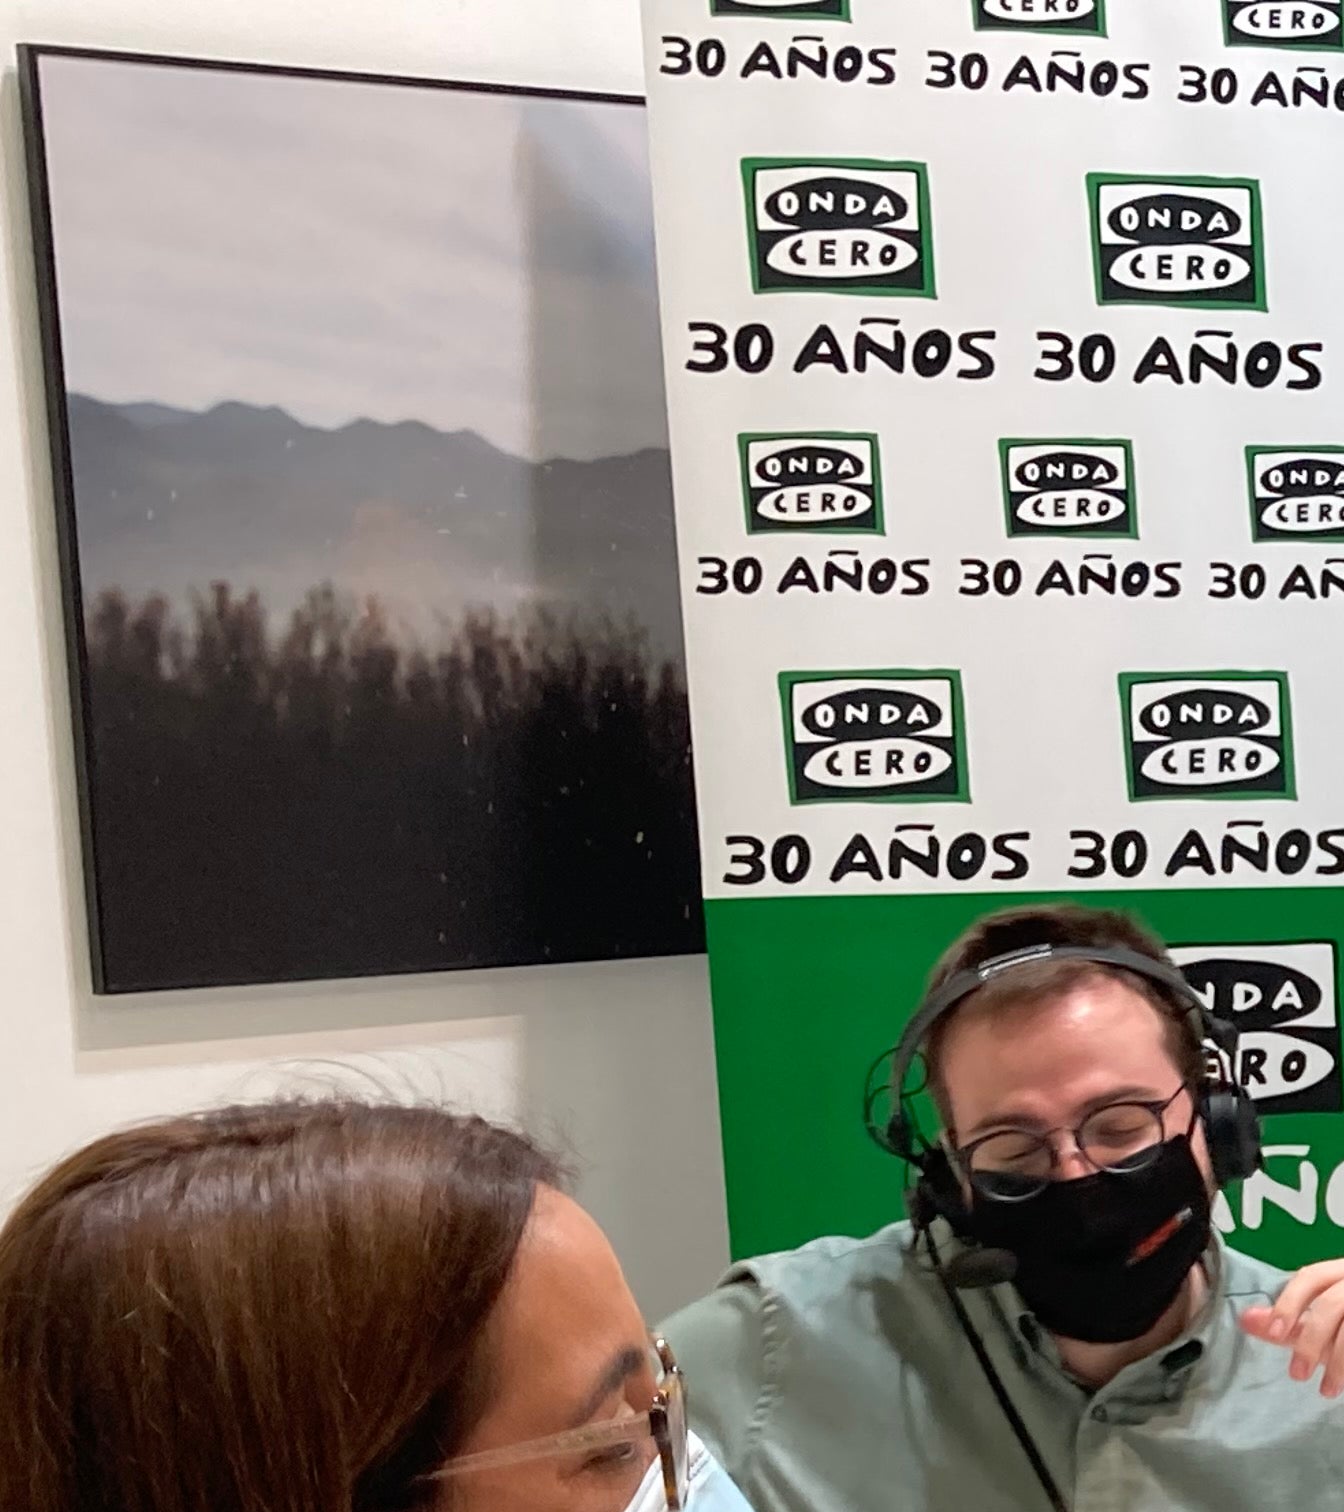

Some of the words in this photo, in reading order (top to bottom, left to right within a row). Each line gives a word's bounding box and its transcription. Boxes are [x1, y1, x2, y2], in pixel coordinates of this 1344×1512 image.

[1248, 8, 1325, 29] CERO
[660, 36, 726, 77] 30
[740, 36, 896, 85] AÑOS
[925, 50, 988, 90] 30
[1002, 51, 1150, 99] AÑOS
[1177, 65, 1238, 105] 30
[777, 191, 895, 217] ONDA
[1119, 206, 1230, 232] ONDA
[788, 239, 897, 266] CERO
[1129, 253, 1231, 280] CERO
[685, 322, 774, 374] 30
[793, 317, 996, 380] AÑOS
[1034, 331, 1116, 383] 30
[1133, 329, 1323, 390] AÑOS
[765, 456, 855, 477] ONDA
[1024, 462, 1110, 482] ONDA
[773, 492, 857, 514] CERO
[1032, 497, 1111, 518] CERO
[696, 556, 763, 595] 30
[777, 550, 930, 596] AÑOS
[958, 558, 1022, 596] 30
[1035, 553, 1182, 598] AÑOS
[1207, 562, 1266, 600] 30
[814, 703, 930, 728] ONDA
[1151, 703, 1259, 728] ONDA
[825, 749, 932, 777] CERO
[1161, 747, 1261, 774] CERO
[722, 834, 811, 886] 30
[829, 824, 1030, 883] AÑOS
[1067, 829, 1148, 879] 30
